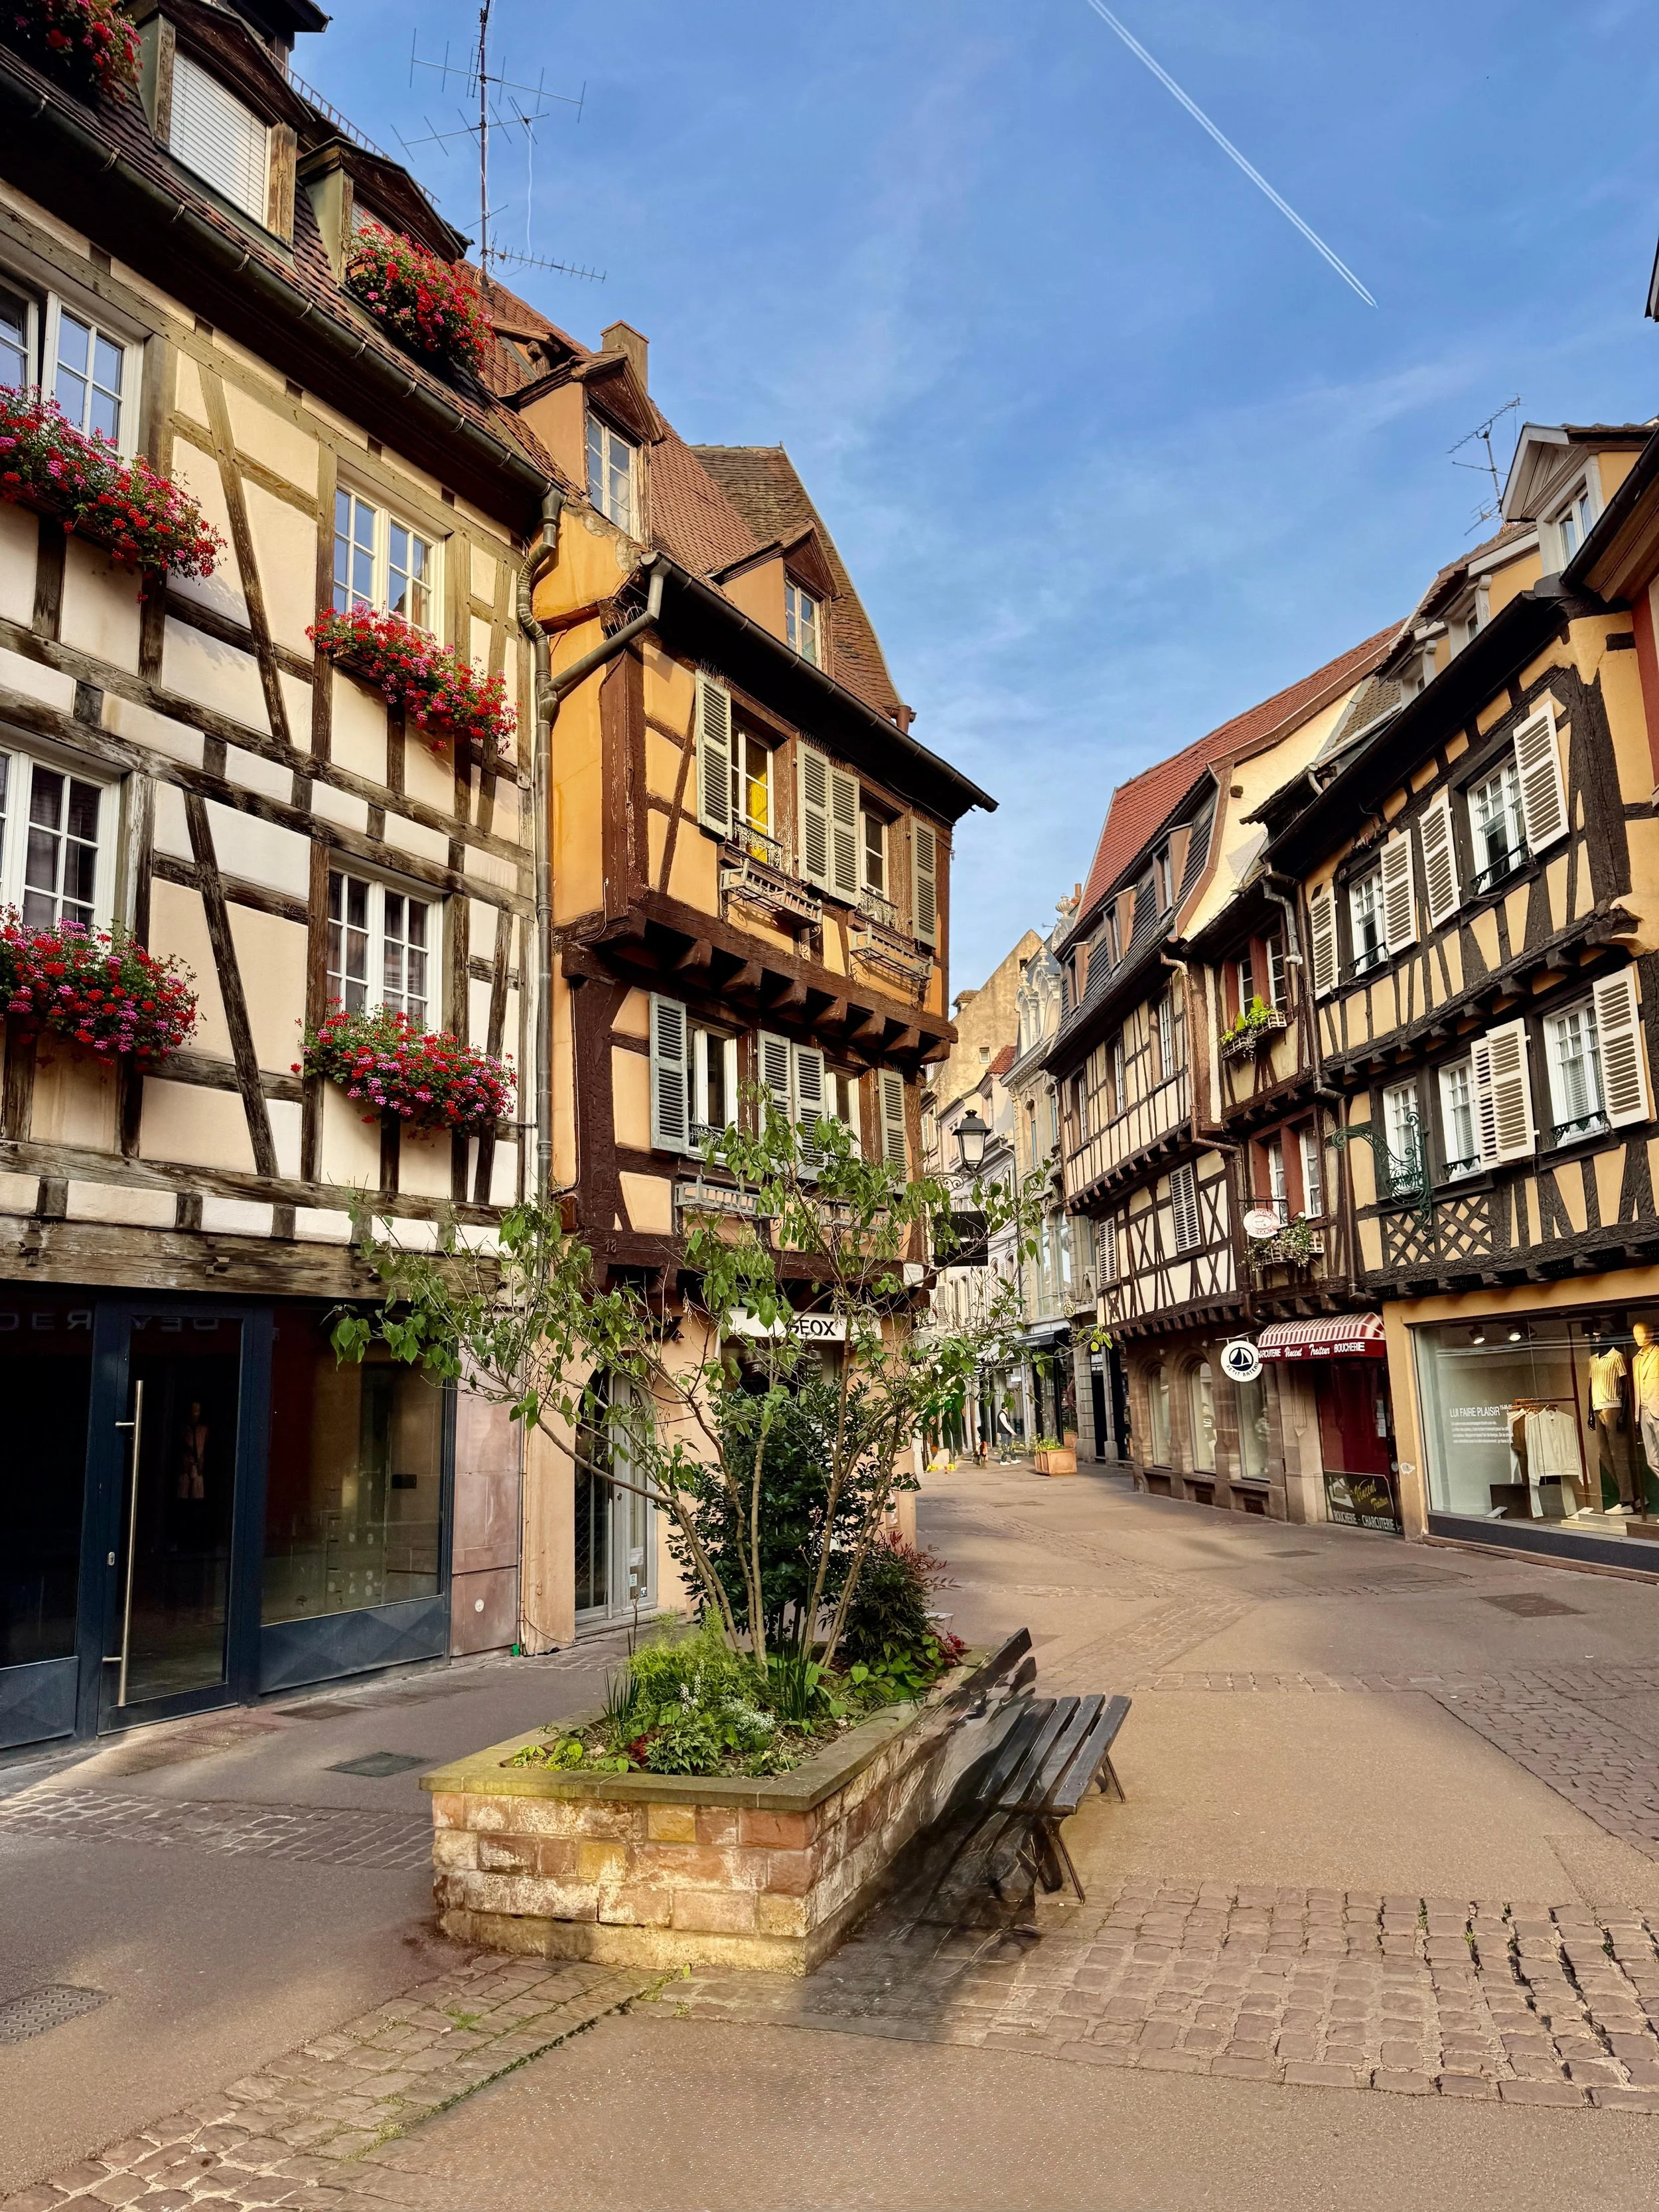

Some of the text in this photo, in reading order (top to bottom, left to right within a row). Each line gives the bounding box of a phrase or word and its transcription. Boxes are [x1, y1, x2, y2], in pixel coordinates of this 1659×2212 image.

[604, 1238, 616, 1253] 18
[1309, 1343, 1331, 1357] Traiteur
[1334, 1341, 1366, 1353] BOUCHERIE
[1226, 1361, 1259, 1377] PETIT BATEAU
[1449, 1408, 1459, 1418] LUI
[1459, 1407, 1477, 1417] FAIRE
[1477, 1406, 1500, 1417] PLAISIR
[1333, 1511, 1358, 1524] BOUCHERIE
[1361, 1514, 1396, 1530] CHARCUTERIE
